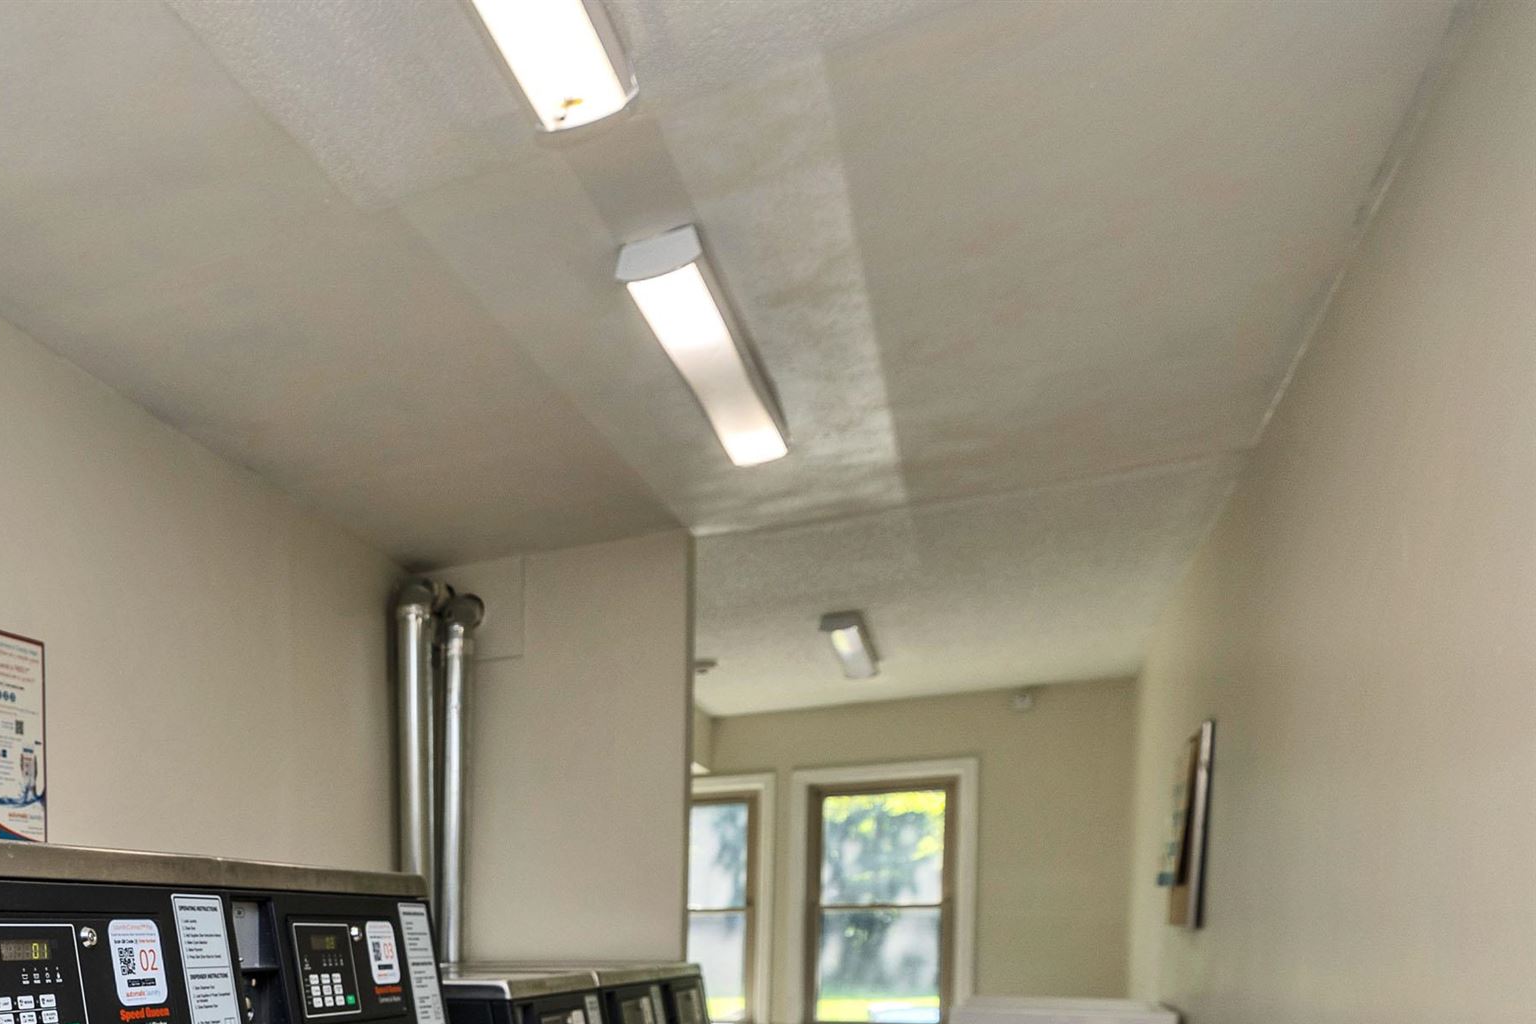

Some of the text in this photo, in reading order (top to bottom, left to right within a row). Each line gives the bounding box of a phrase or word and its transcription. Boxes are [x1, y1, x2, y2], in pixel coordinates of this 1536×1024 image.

[140, 949, 158, 971] 02
[120, 1007, 170, 1022] Speed Queen
